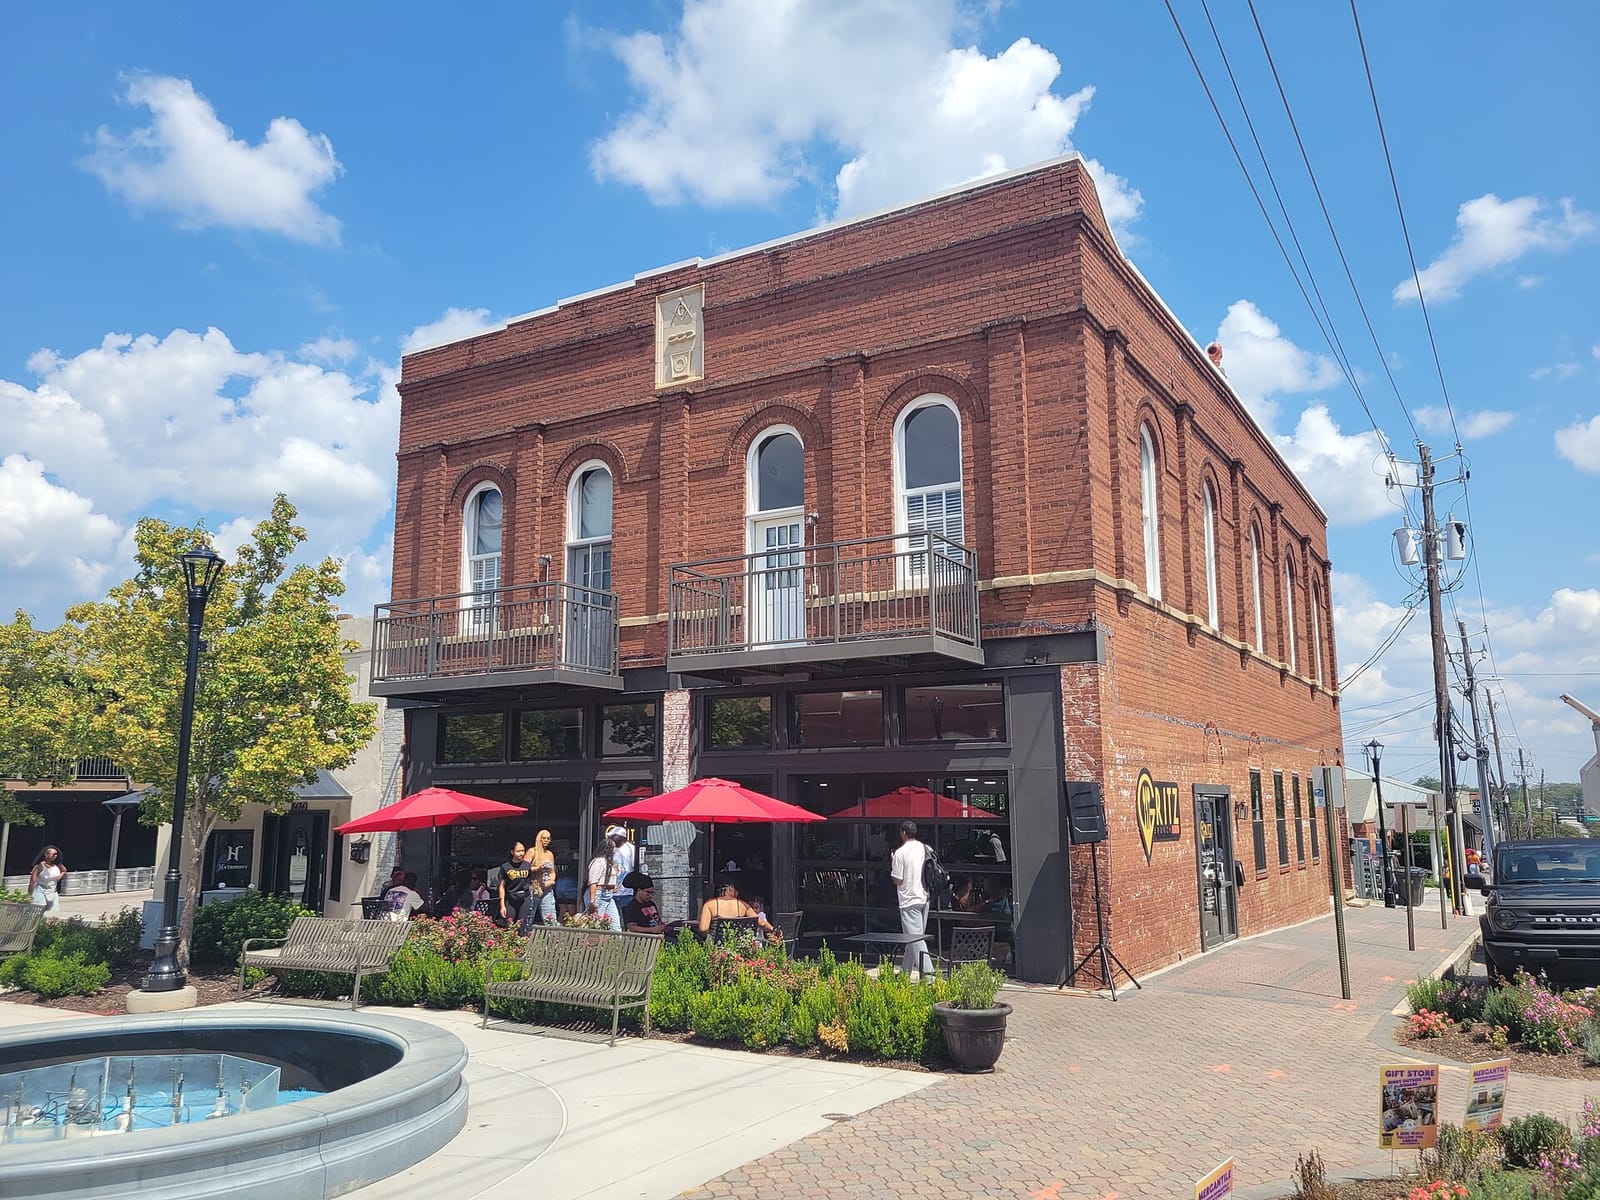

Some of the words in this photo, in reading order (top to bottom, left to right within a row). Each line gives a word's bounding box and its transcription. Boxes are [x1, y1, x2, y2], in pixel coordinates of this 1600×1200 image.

[1137, 773, 1180, 830] GRITZ
[1407, 1069, 1435, 1077] STORE
[1473, 1065, 1507, 1077] MERCANTILE
[1198, 1169, 1232, 1200] MERCANTILE
